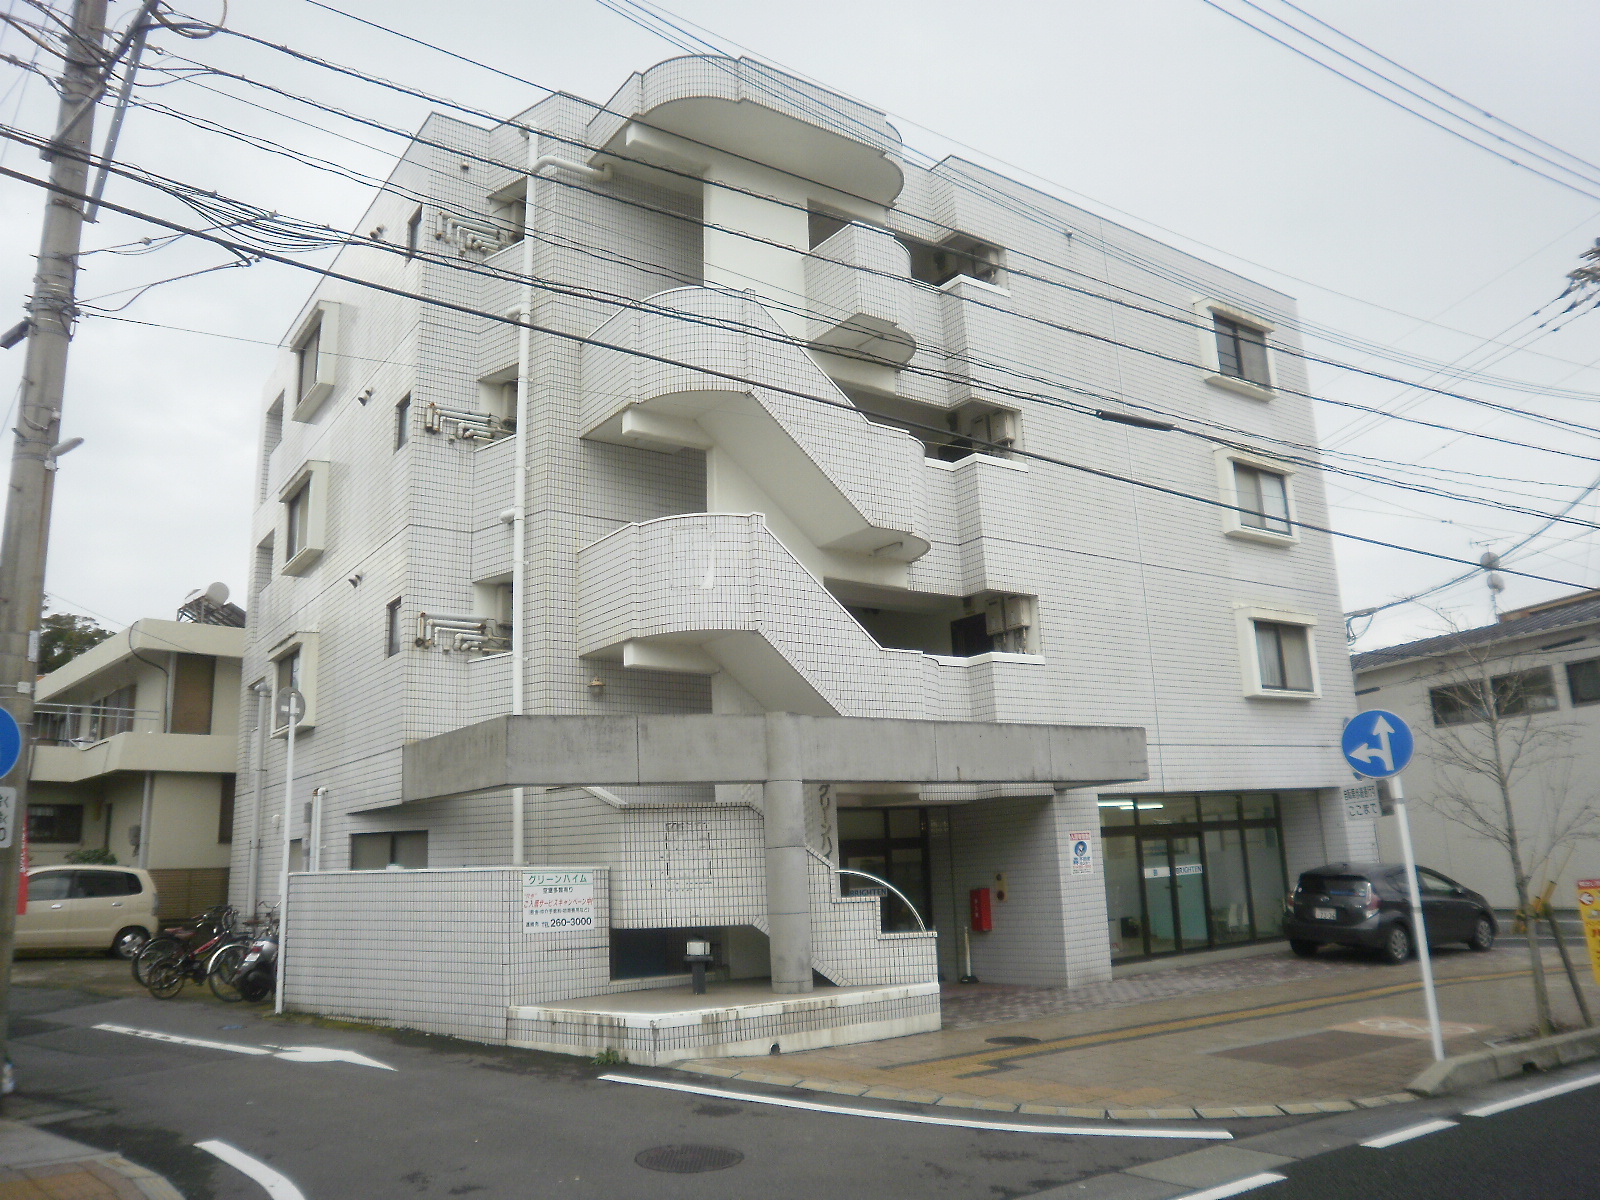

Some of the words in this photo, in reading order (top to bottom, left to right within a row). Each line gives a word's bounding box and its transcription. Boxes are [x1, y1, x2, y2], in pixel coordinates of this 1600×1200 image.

[1349, 803, 1377, 816] ここまで
[1176, 865, 1203, 875] BRIGHTEN
[528, 874, 587, 885] グリーンハイム
[850, 888, 887, 897] BRIGHTEN
[550, 917, 592, 928] 260-3000
